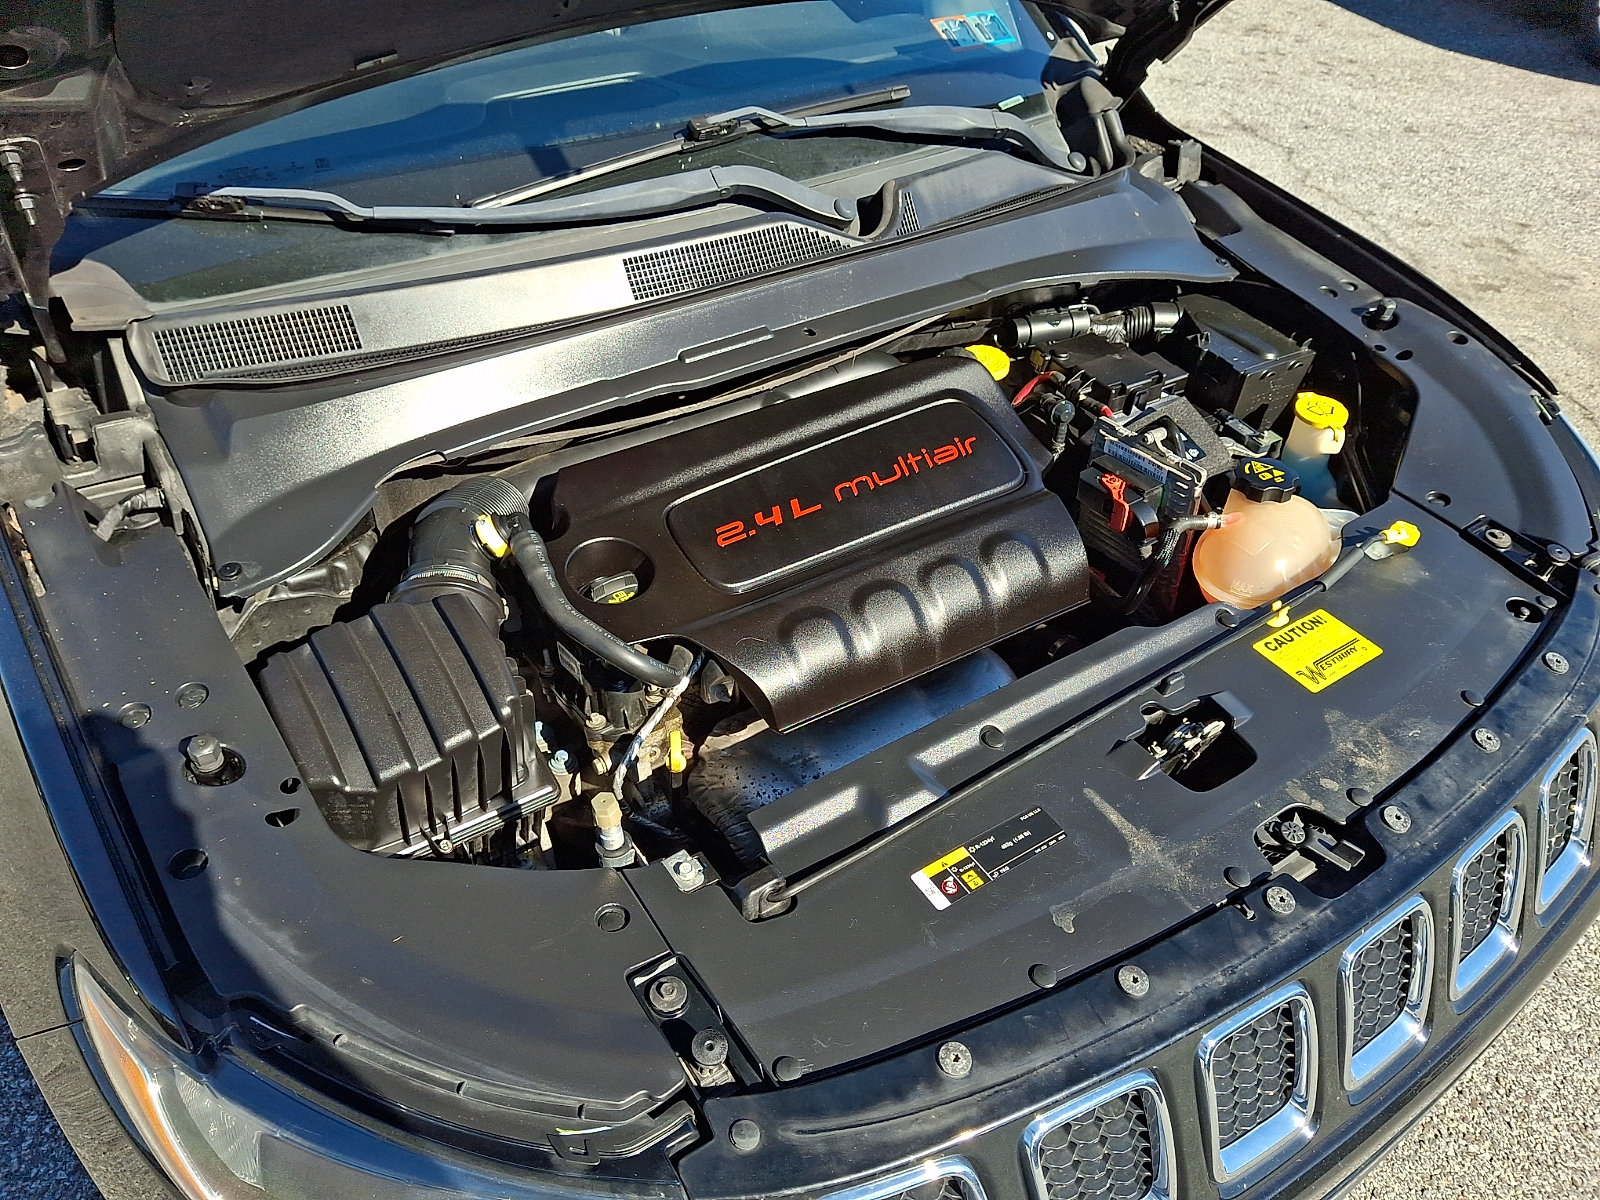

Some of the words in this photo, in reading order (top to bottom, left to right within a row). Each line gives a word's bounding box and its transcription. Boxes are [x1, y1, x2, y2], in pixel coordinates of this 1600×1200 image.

[832, 436, 978, 502] multiair
[1264, 614, 1328, 652] CAUTION!
[1295, 645, 1358, 684] WESTBURY
